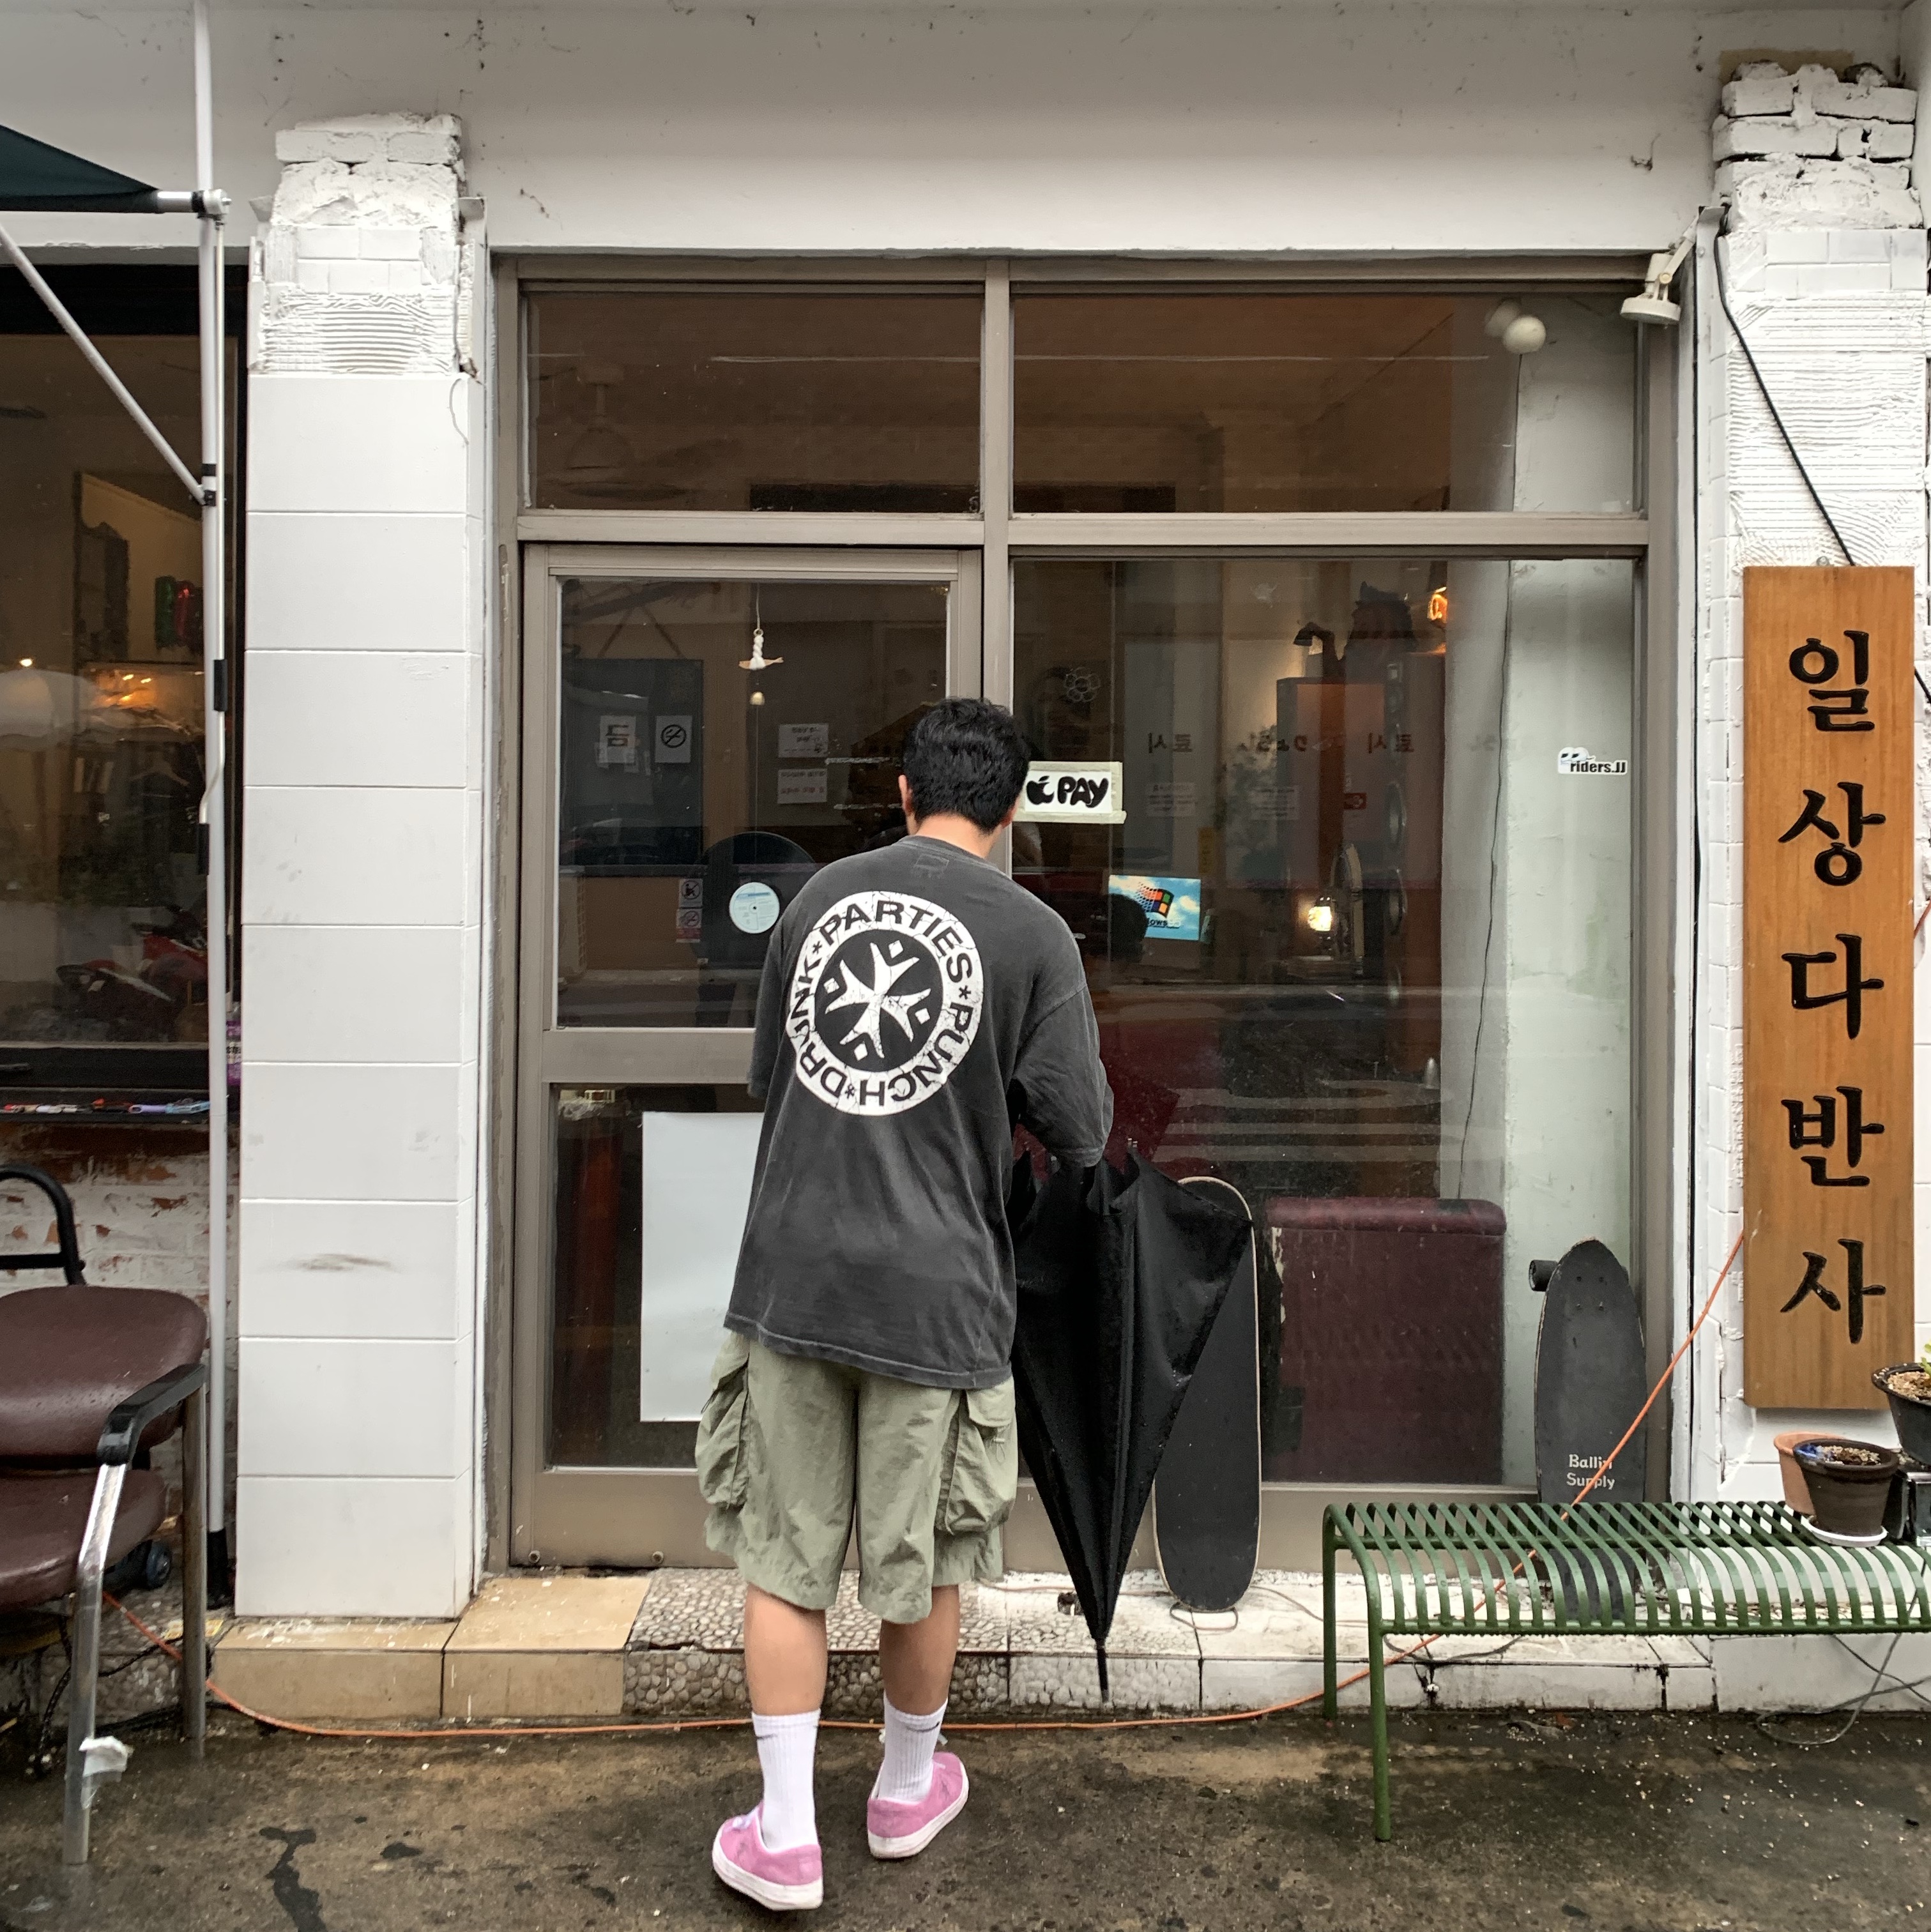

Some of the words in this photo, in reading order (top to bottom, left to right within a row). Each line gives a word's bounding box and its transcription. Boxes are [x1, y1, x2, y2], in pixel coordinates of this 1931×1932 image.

[1057, 775, 1109, 809] PAY
[820, 899, 973, 984] PARTIES
[1778, 630, 1886, 1344] 일상다반사
[790, 957, 847, 1099] DRUNK
[859, 1001, 974, 1106] PUNCH
